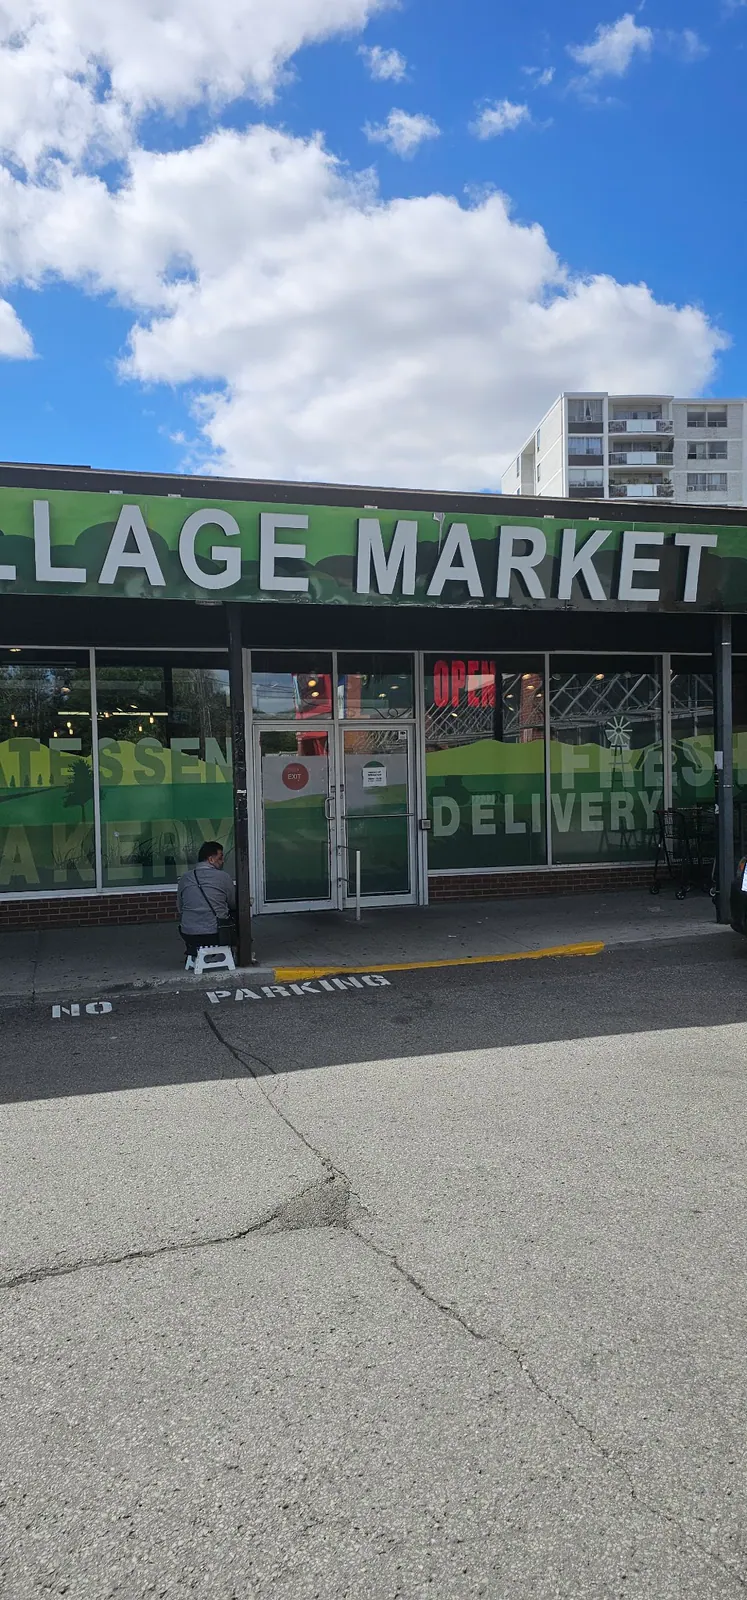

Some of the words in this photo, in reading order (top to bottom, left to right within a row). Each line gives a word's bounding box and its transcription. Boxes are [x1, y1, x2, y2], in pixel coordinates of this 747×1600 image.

[355, 518, 718, 602] MARKET
[433, 661, 496, 708] OPEN
[433, 790, 662, 837] DELIVERY
[52, 1001, 112, 1018] NO
[206, 974, 391, 1003] PARKING
